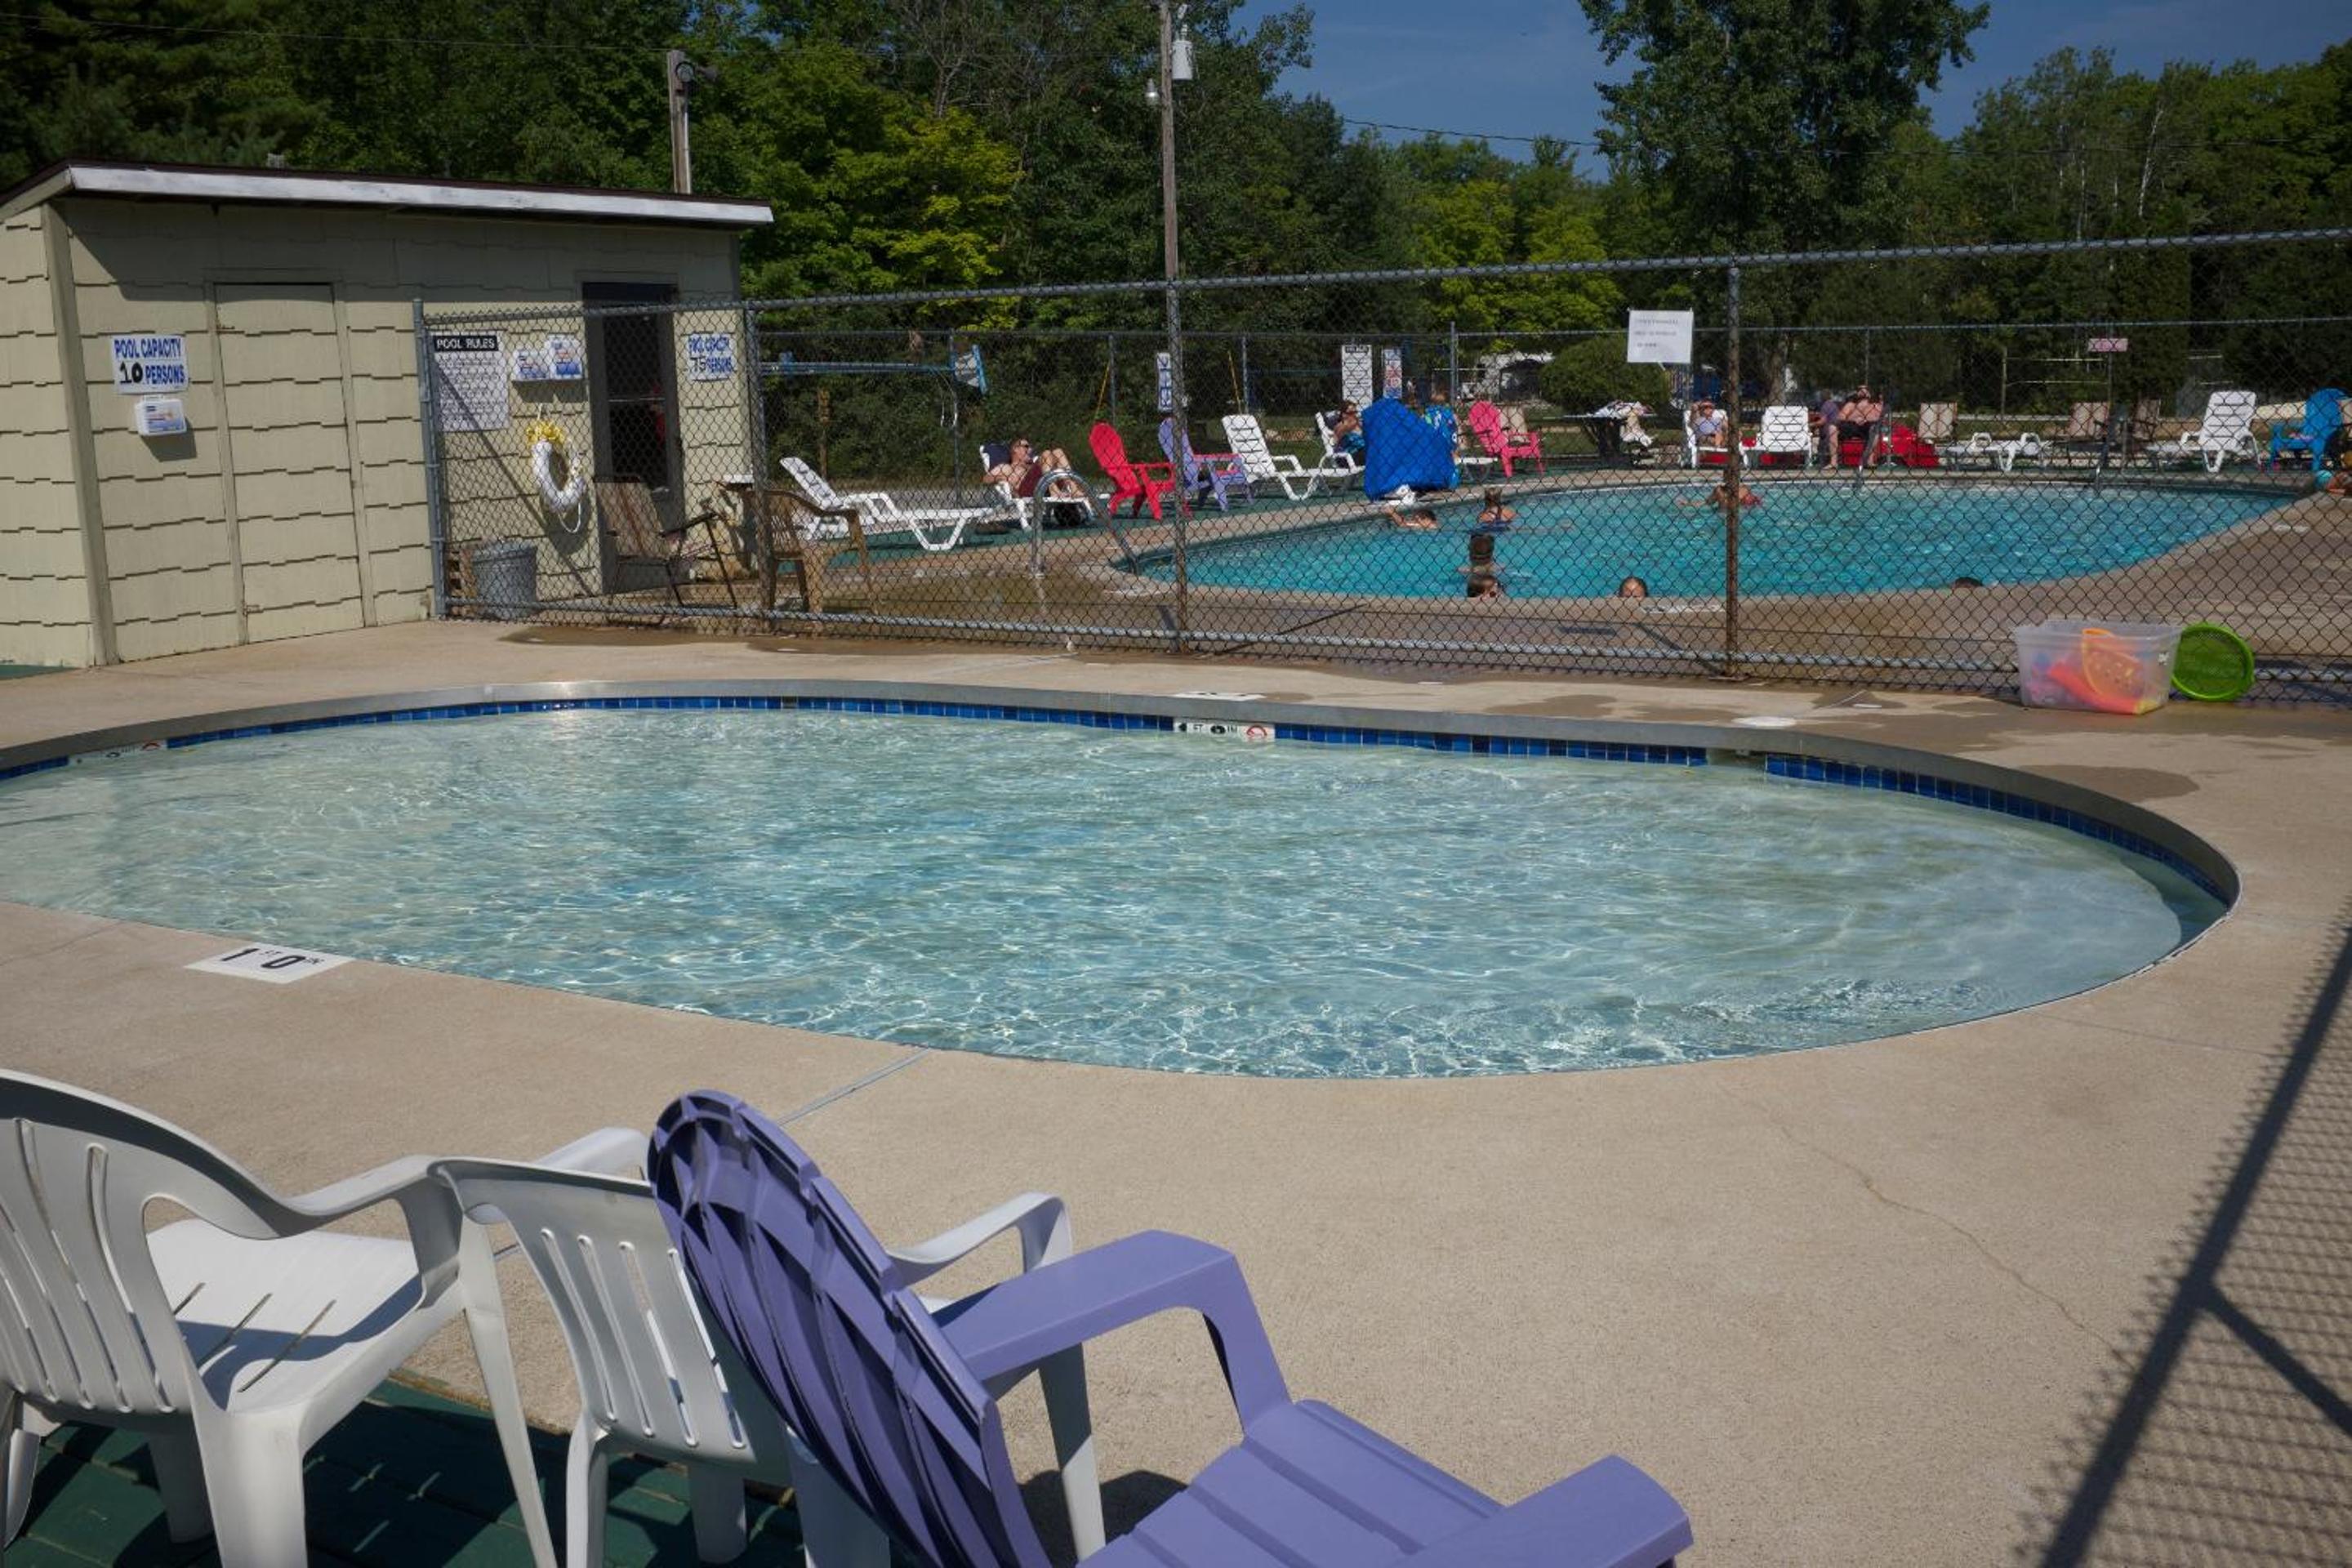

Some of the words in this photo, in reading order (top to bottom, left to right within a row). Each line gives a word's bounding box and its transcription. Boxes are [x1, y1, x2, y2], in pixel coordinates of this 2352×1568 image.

[114, 339, 140, 358] POOL
[140, 337, 181, 358] CAPACITY
[437, 338, 462, 350] POOL
[466, 337, 496, 350] RULES
[119, 361, 143, 384] 10
[145, 364, 186, 384] PERSONS
